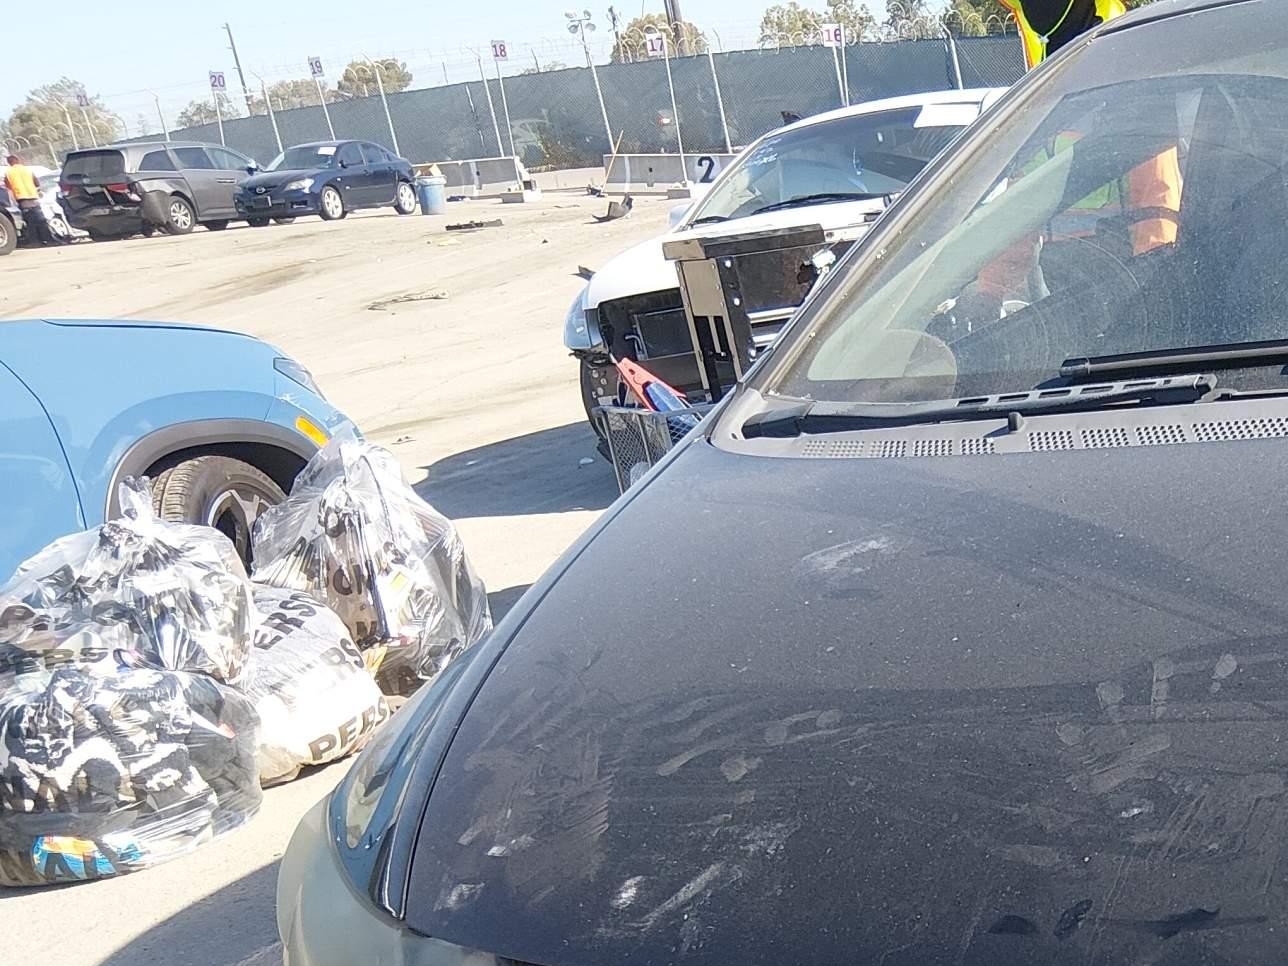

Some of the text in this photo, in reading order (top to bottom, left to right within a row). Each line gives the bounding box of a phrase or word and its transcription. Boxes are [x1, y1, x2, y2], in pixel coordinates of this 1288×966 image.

[824, 28, 841, 42] 16
[492, 44, 507, 57] 18
[648, 41, 663, 52] 17
[310, 60, 323, 75] 19
[209, 74, 225, 88] 20
[697, 156, 715, 184] 2
